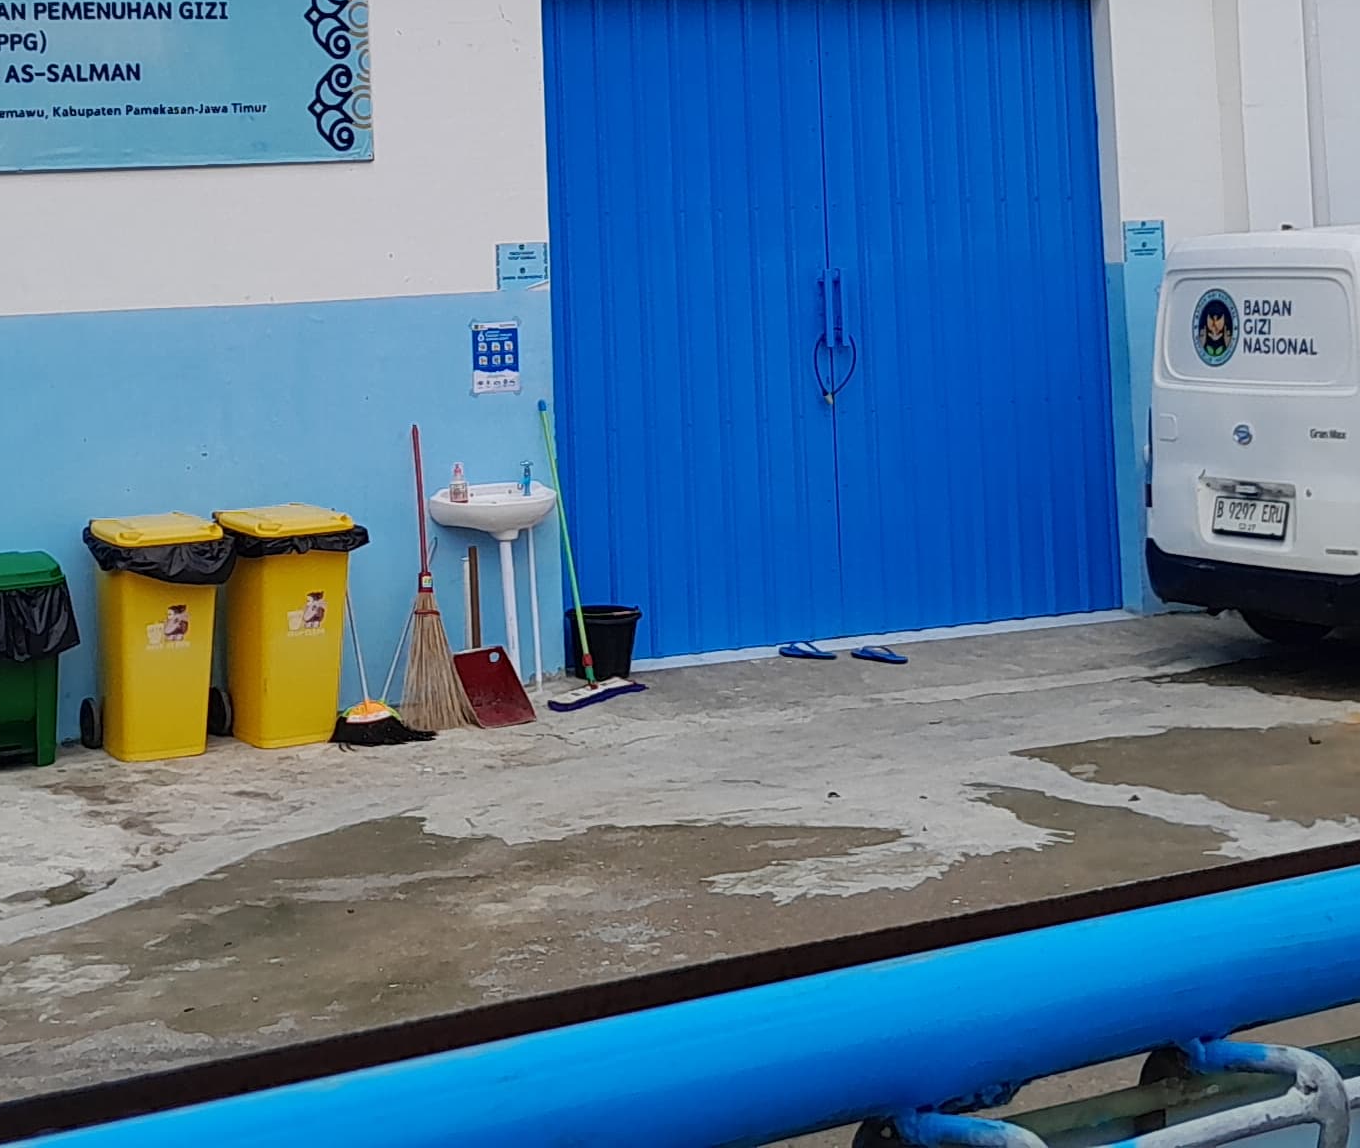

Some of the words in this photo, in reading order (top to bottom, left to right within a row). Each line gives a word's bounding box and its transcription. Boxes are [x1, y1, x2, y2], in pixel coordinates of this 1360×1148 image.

[33, 1, 172, 21] PEMENUHAN
[178, 1, 229, 20] GIZI
[4, 62, 141, 84] AS-SALMAN
[52, 105, 122, 119] Kabupaten
[125, 103, 229, 116] Pamekasan-Jawa
[231, 102, 268, 114] Timur
[1243, 299, 1293, 317] BADAN
[1243, 318, 1272, 335] GIZI
[1242, 337, 1318, 356] NASIONAL
[1216, 500, 1225, 519] B
[1228, 501, 1257, 521] 9297
[1261, 504, 1284, 524] ERU
